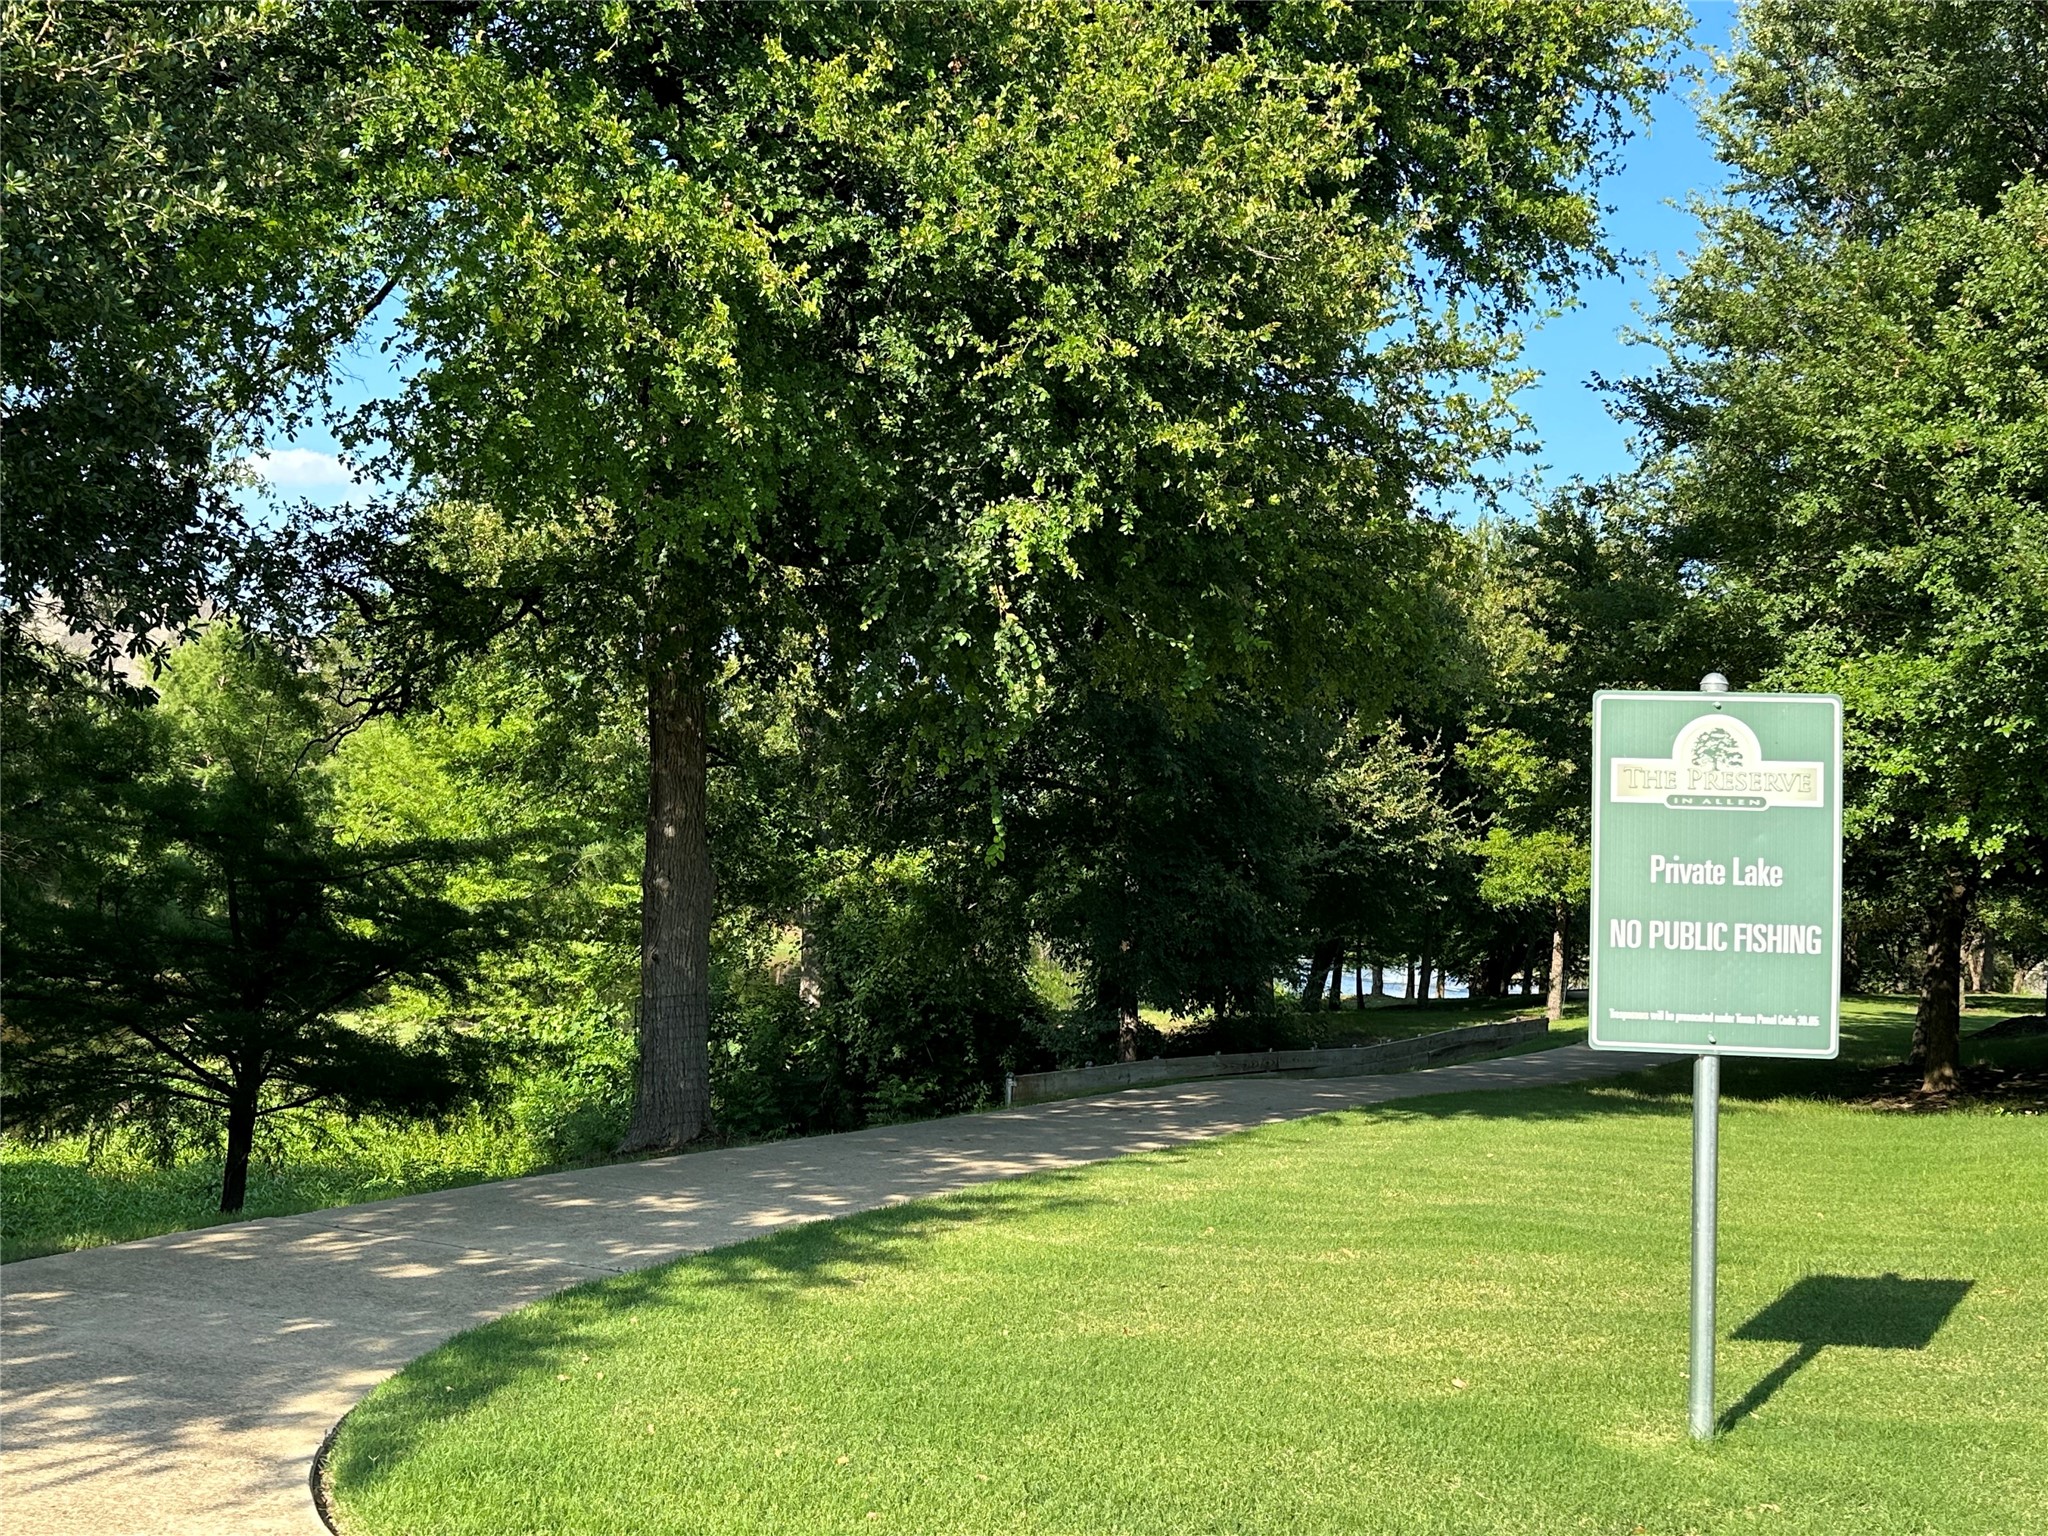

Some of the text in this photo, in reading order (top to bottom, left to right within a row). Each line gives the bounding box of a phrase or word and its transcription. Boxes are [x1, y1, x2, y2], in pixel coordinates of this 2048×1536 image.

[1623, 766, 1812, 793] THE PRESERVE
[1673, 797, 1761, 806] IN ALLEN
[1650, 854, 1783, 888] Private Lake
[1610, 918, 1822, 955] NO PUBLIC FISHING
